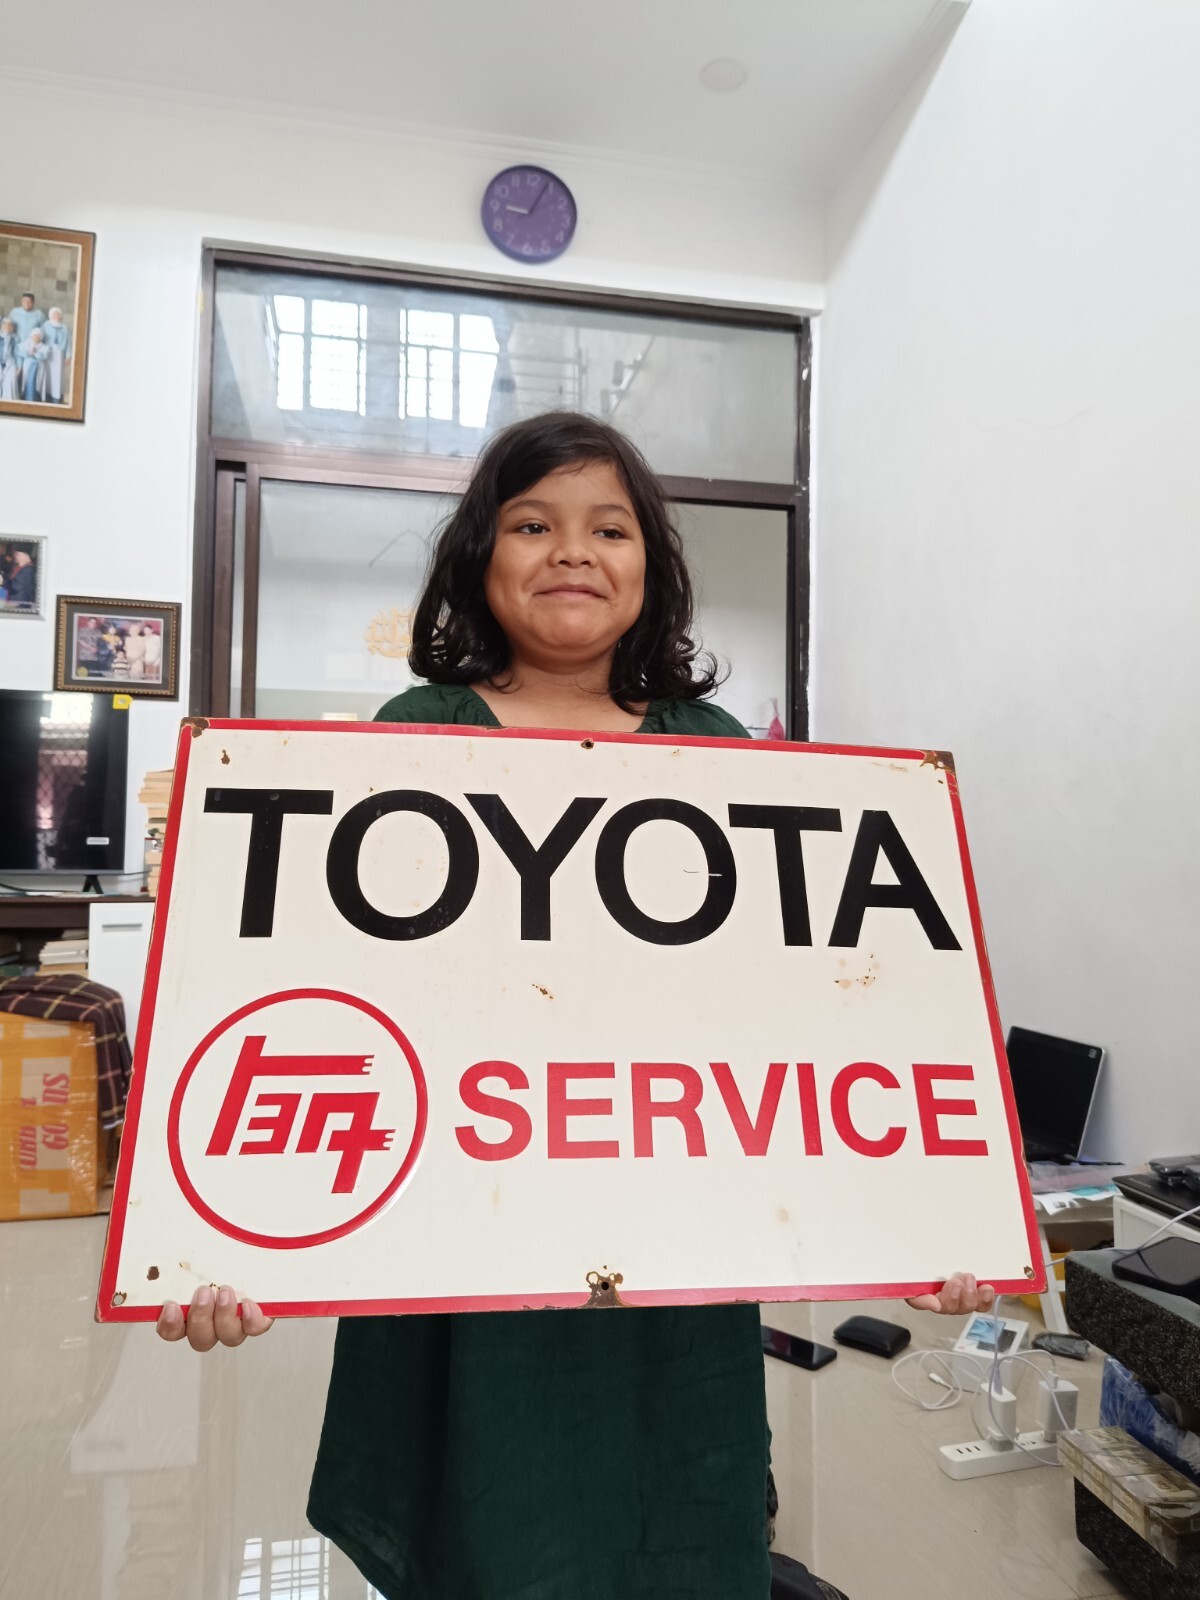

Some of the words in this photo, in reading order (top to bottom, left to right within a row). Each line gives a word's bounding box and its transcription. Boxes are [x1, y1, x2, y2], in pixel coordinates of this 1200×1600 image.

[526, 173, 540, 187] 12
[494, 183, 509, 198] 10
[489, 199, 500, 213] 9
[557, 196, 567, 210] 2
[493, 218, 503, 232] 8
[561, 214, 571, 228] 3
[554, 230, 565, 243] 4
[522, 242, 533, 255] 6
[204, 788, 963, 951] TOYOTA
[43, 1073, 70, 1150] GODS
[456, 1059, 988, 1161] SERVICE
